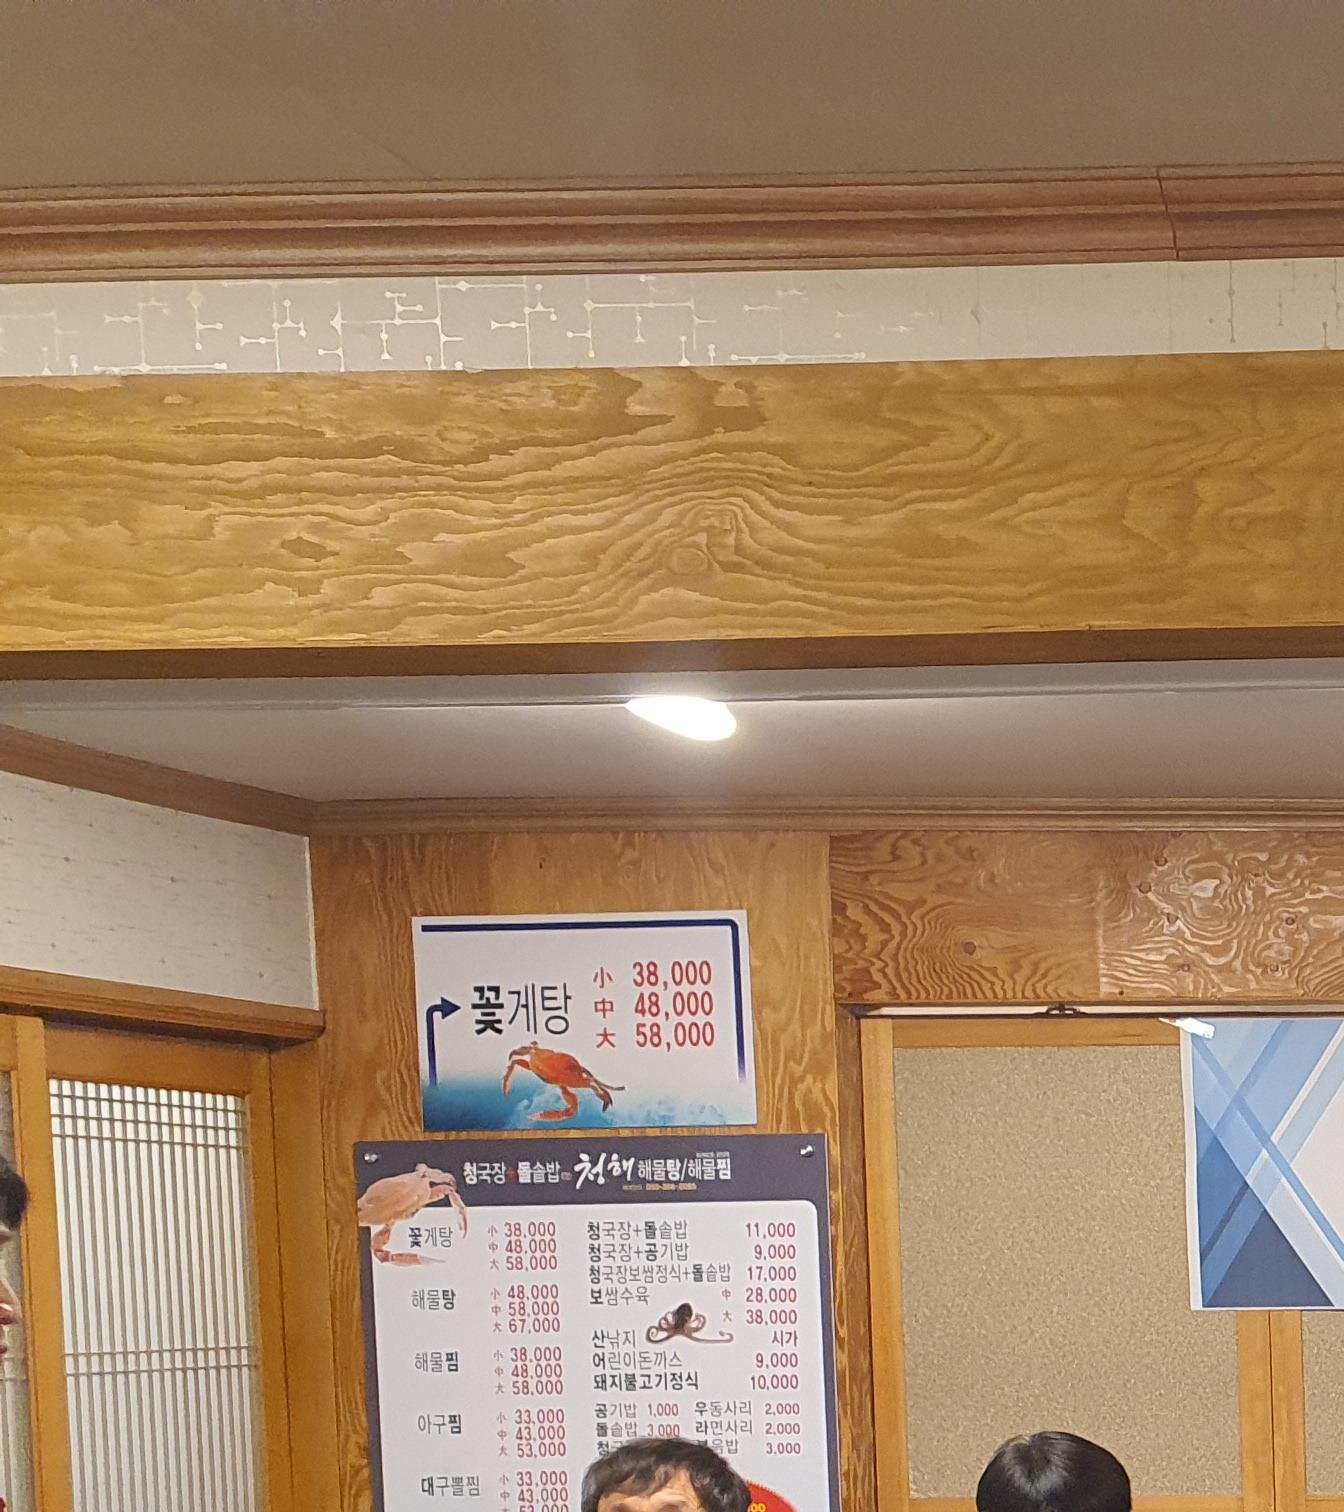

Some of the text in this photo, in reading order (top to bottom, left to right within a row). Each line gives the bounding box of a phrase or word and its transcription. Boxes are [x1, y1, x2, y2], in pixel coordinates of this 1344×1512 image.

[593, 960, 712, 991] 小 38,000
[471, 983, 572, 1035] 꽃게탕
[594, 991, 713, 1021] 中 48,000
[596, 1021, 715, 1052] 大 58,000
[574, 1152, 635, 1190] 청해
[408, 1226, 453, 1248] 꽃게탕
[504, 1222, 556, 1238] 38,000
[746, 1223, 796, 1239] 11,000
[505, 1238, 557, 1254] 48,000
[588, 1242, 796, 1263] 청국장+공기밥 9,000
[506, 1255, 557, 1271] 58,000
[747, 1266, 797, 1283] 17,000
[412, 1289, 456, 1310] 해물탕
[508, 1284, 559, 1300] 48,000
[590, 1286, 649, 1306] 보쌈수육
[745, 1288, 797, 1304] 28,000
[509, 1301, 560, 1317] 58,000
[746, 1309, 797, 1326] 38,000
[509, 1317, 560, 1334] 67,000
[772, 1330, 798, 1347] 시가
[415, 1351, 459, 1372] 해물찜
[510, 1347, 562, 1363] 38,000
[593, 1351, 798, 1371] 어린이돈까스 9,000
[511, 1363, 562, 1379] 48,000
[512, 1380, 563, 1396] 58,000
[594, 1371, 799, 1391] 돼지불고기정식 10,000
[595, 1400, 800, 1418] 공기밥 1,000 우동사리 2,000
[418, 1414, 462, 1434] 아구찜
[515, 1409, 565, 1426] 33,000
[695, 1420, 752, 1436] 라면사리
[765, 1423, 800, 1436] 2,000
[516, 1425, 565, 1442] 43,000
[517, 1442, 566, 1458] 53,000
[766, 1443, 800, 1456] 3,000
[517, 1471, 567, 1487] 33,000
[518, 1487, 568, 1504] 43,000
